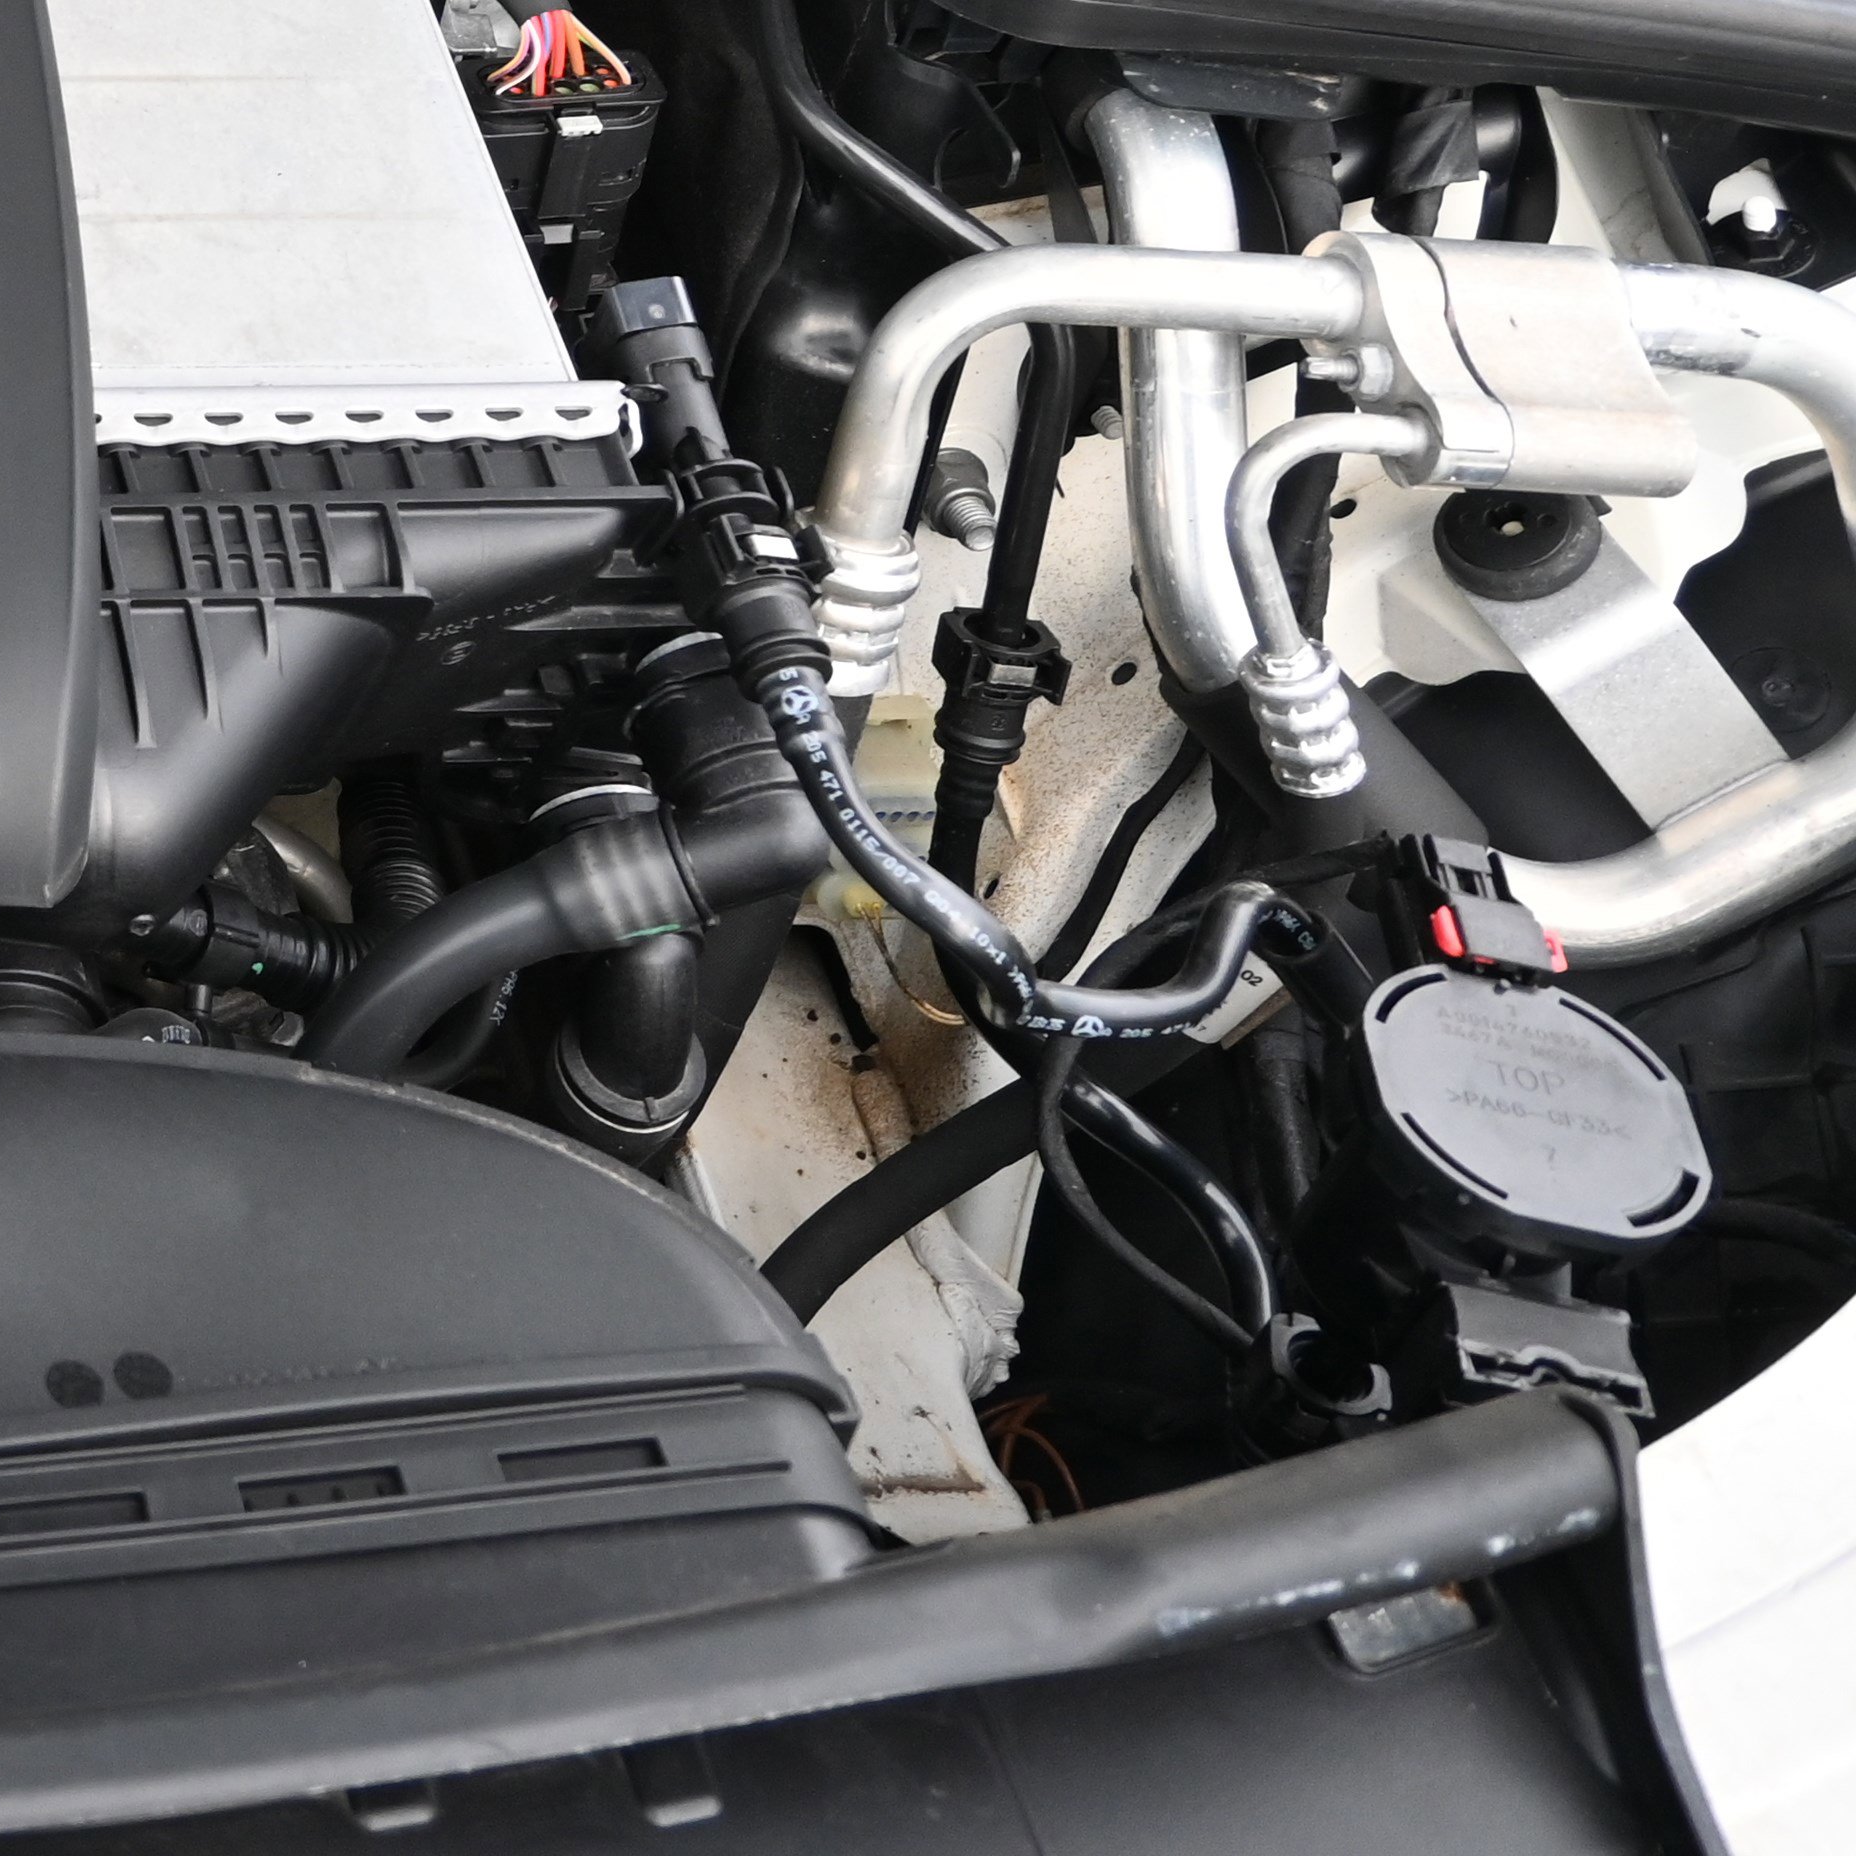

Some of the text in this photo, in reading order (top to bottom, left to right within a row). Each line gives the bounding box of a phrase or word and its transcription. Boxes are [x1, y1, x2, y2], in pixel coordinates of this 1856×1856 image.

[803, 731, 828, 763] 205
[820, 769, 844, 801] 471
[1488, 1059, 1566, 1095] TOP
